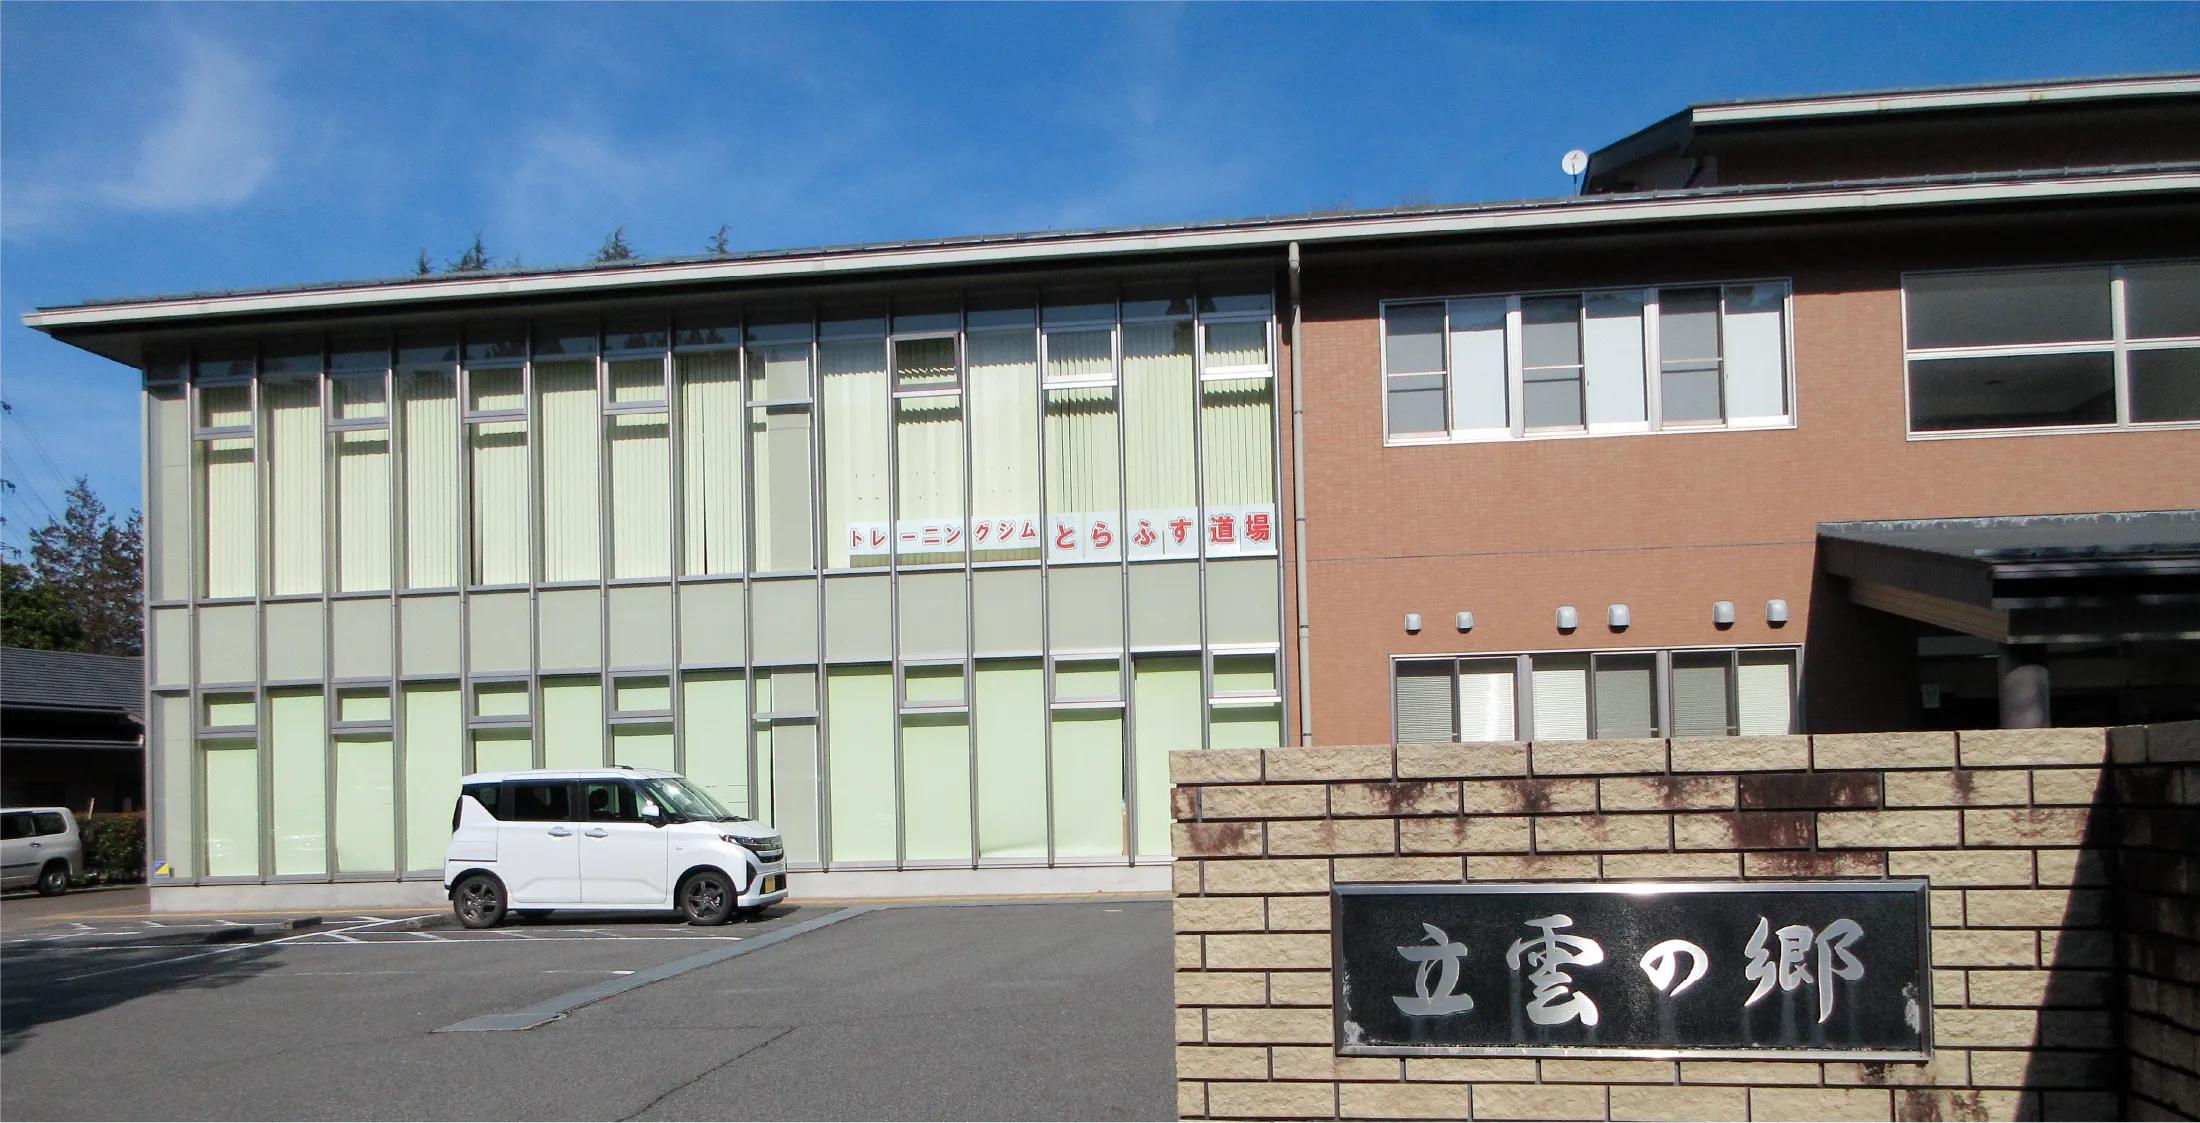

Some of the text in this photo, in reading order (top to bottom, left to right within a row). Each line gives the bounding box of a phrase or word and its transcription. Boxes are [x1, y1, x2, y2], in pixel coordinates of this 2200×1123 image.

[1055, 513, 1272, 550] とらふす道場
[1392, 913, 1865, 1026] 立雲の郷
